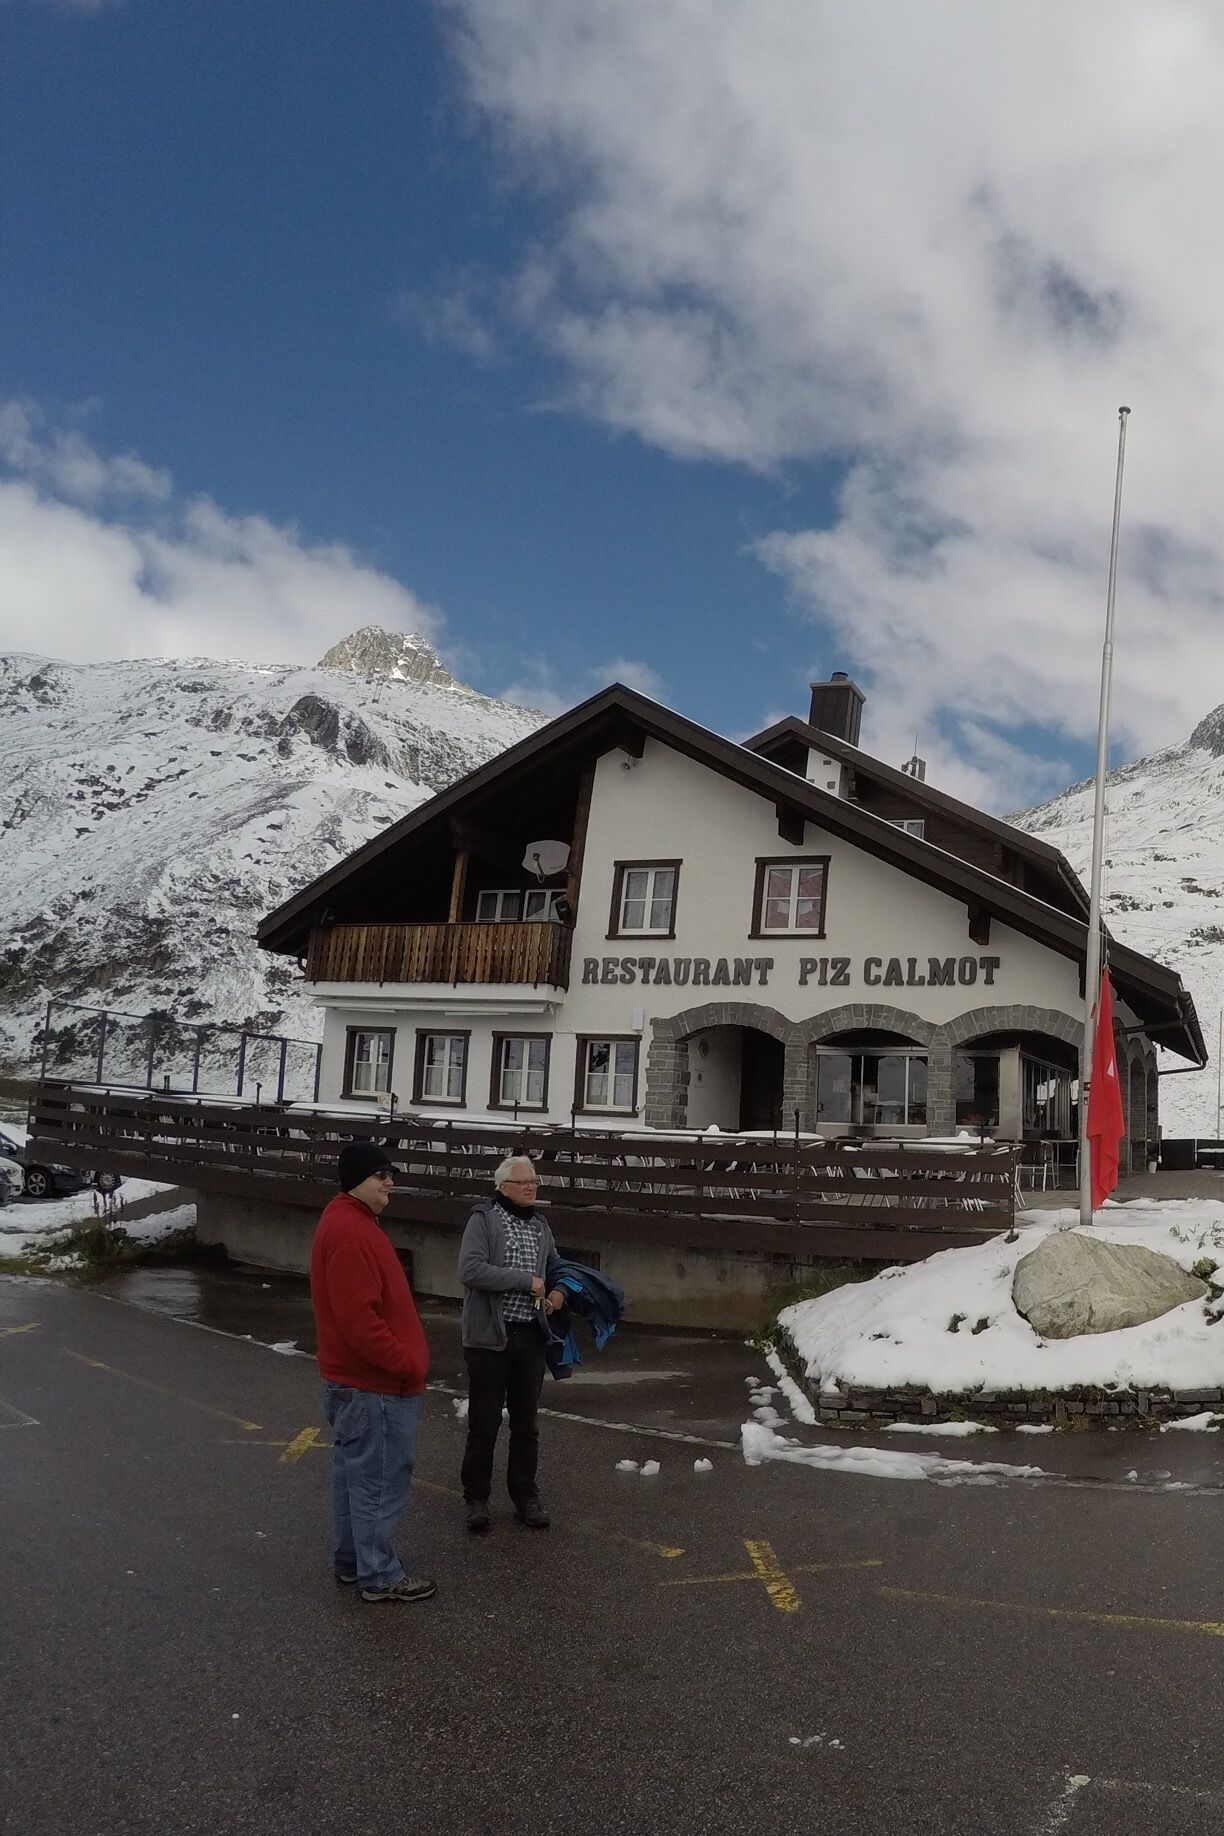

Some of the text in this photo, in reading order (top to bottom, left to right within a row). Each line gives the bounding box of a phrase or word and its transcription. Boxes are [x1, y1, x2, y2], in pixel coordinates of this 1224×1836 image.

[581, 956, 1000, 986] RESTAURANT PIZ CALMOT
